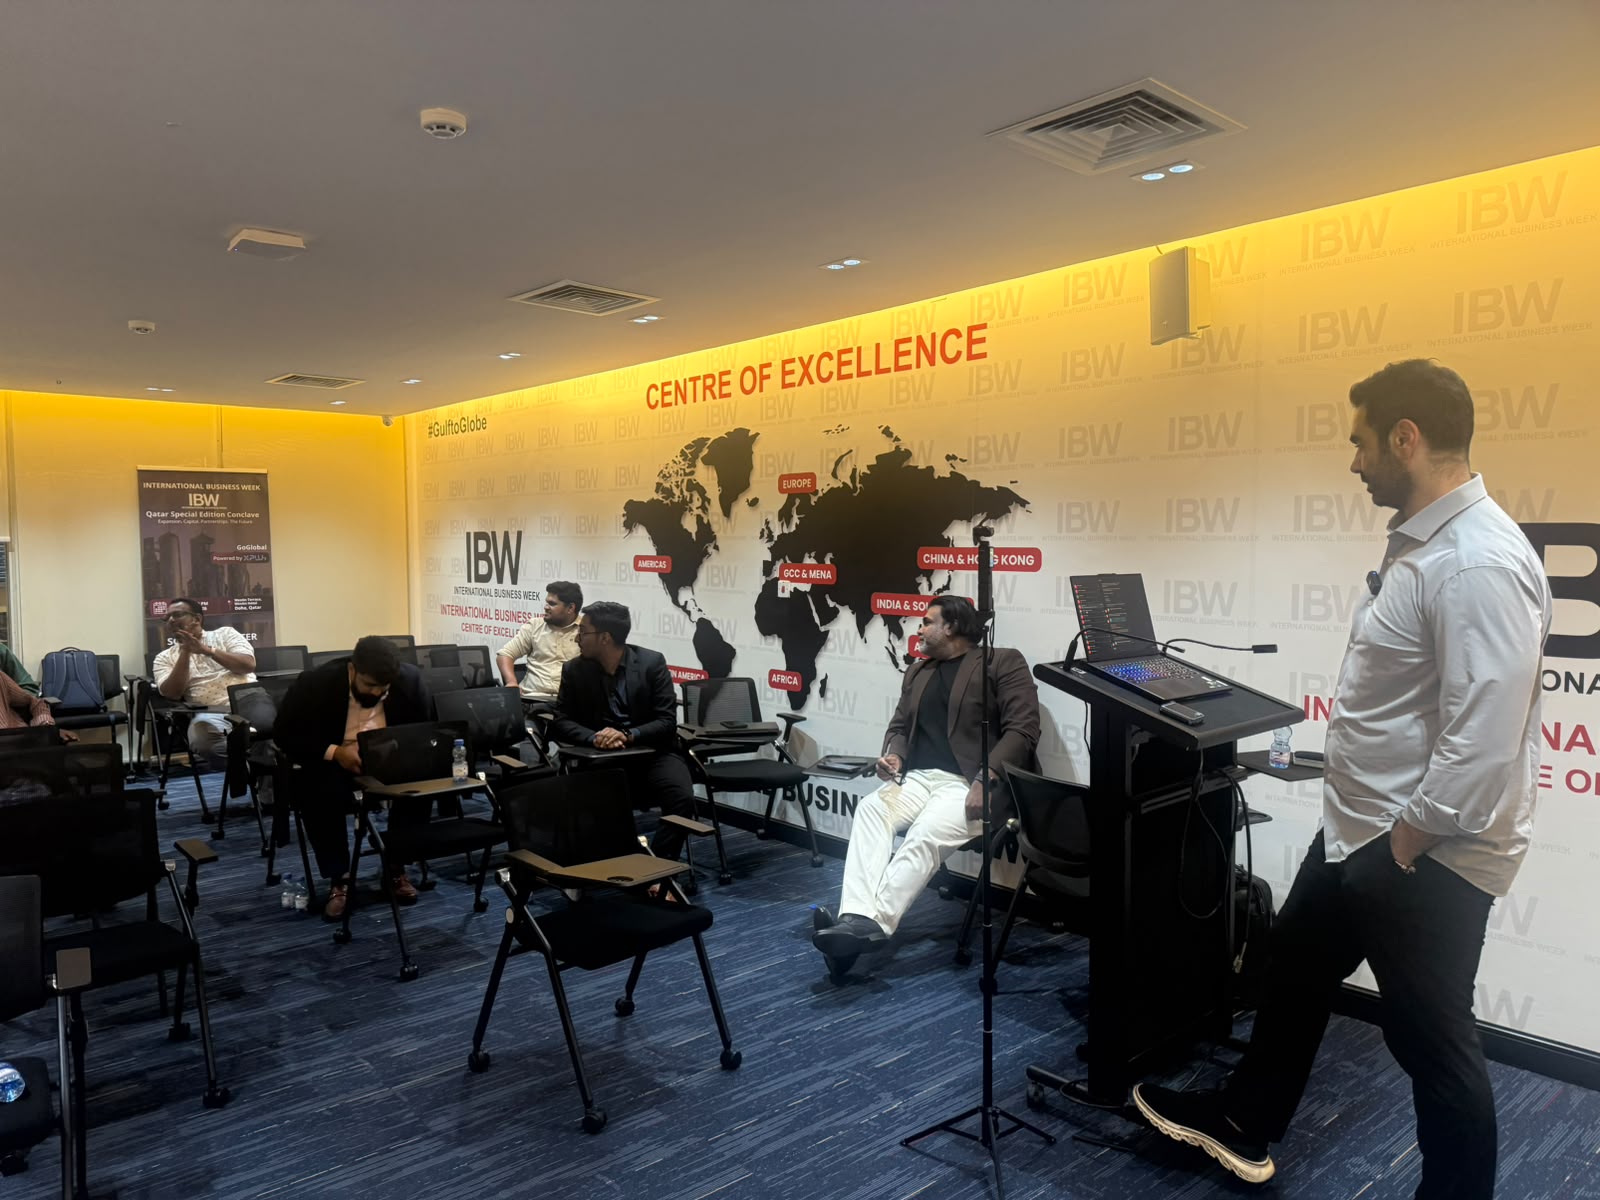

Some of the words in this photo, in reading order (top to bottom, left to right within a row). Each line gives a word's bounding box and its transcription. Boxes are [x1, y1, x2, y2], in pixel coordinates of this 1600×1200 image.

[1456, 170, 1568, 234] IBW
[1300, 207, 1392, 262] IBW
[1430, 229, 1507, 249] INTERNATIONAL
[1510, 219, 1562, 235] BUSINESS
[1565, 213, 1598, 226] WEEK
[1279, 259, 1342, 276] INTERNATIONAL
[1344, 250, 1387, 264] BUSINESS
[1390, 245, 1416, 257] WEEK
[1063, 262, 1127, 307] IBW
[970, 285, 1024, 324] IBW
[1453, 277, 1564, 334] IBW
[890, 304, 936, 340] IBW
[1298, 302, 1389, 353] IBW
[1427, 333, 1504, 347] INTERNATIONAL
[1507, 325, 1558, 338] BUSINESS
[1561, 321, 1593, 332] WEEK
[646, 369, 732, 410] CENTRE
[740, 362, 772, 395] OF
[781, 323, 988, 390] EXCELLENCE
[1061, 342, 1125, 384] IBW
[1277, 351, 1338, 365] INTERNATIONAL
[889, 372, 936, 405] IBW
[968, 359, 1022, 396] IBW
[760, 392, 795, 421] IBW
[820, 382, 860, 414] IBW
[1471, 384, 1560, 432] BW
[658, 408, 686, 433] IBW
[706, 400, 737, 427] IBW
[1296, 401, 1354, 443] IB
[428, 414, 487, 438] #GulftoGlobe
[538, 426, 559, 447] IBW
[574, 421, 598, 443] IBW
[615, 416, 640, 440] IBW
[1168, 410, 1243, 452] IBW
[506, 432, 525, 450] IBW
[967, 432, 1021, 465] IBW
[1058, 422, 1123, 459] IBW
[615, 464, 640, 487] IBW
[760, 451, 795, 478] IBW
[143, 482, 204, 490] INTERNATIONAL
[506, 473, 526, 493] IBW
[539, 472, 560, 490] IBW
[575, 468, 599, 488] IBW
[783, 479, 812, 489] EUROPE
[188, 493, 219, 507] IBW
[170, 511, 197, 519] Special
[576, 514, 599, 534] IBW
[1057, 500, 1120, 534] IBW
[1165, 497, 1240, 533] IBW
[1294, 493, 1378, 533] IBW
[540, 516, 560, 535] IBW
[1272, 533, 1336, 543] INTERNATIONAL
[466, 530, 522, 585] IBW
[541, 560, 561, 578] IBW
[638, 560, 667, 569] AMERICAS
[923, 554, 953, 564] CHINA
[957, 555, 965, 565] &
[1001, 555, 1035, 566] KONG
[577, 561, 599, 580] IBW
[706, 566, 737, 588] IBW
[783, 568, 800, 578] GCC
[801, 569, 808, 578] &
[809, 570, 832, 579] MENA
[454, 586, 493, 598] INTERNATIONAL
[494, 589, 522, 600] BUSINESS
[523, 590, 540, 602] WEEK
[876, 599, 902, 609] INDIA
[903, 600, 911, 610] &
[1164, 580, 1238, 616] IBW
[440, 604, 493, 620] INTERNATIONAL
[495, 609, 532, 624] BUSINESS
[658, 613, 687, 635] IBW
[461, 623, 483, 634] CENTRE
[484, 626, 492, 635] OF
[771, 674, 798, 686] AFRICA
